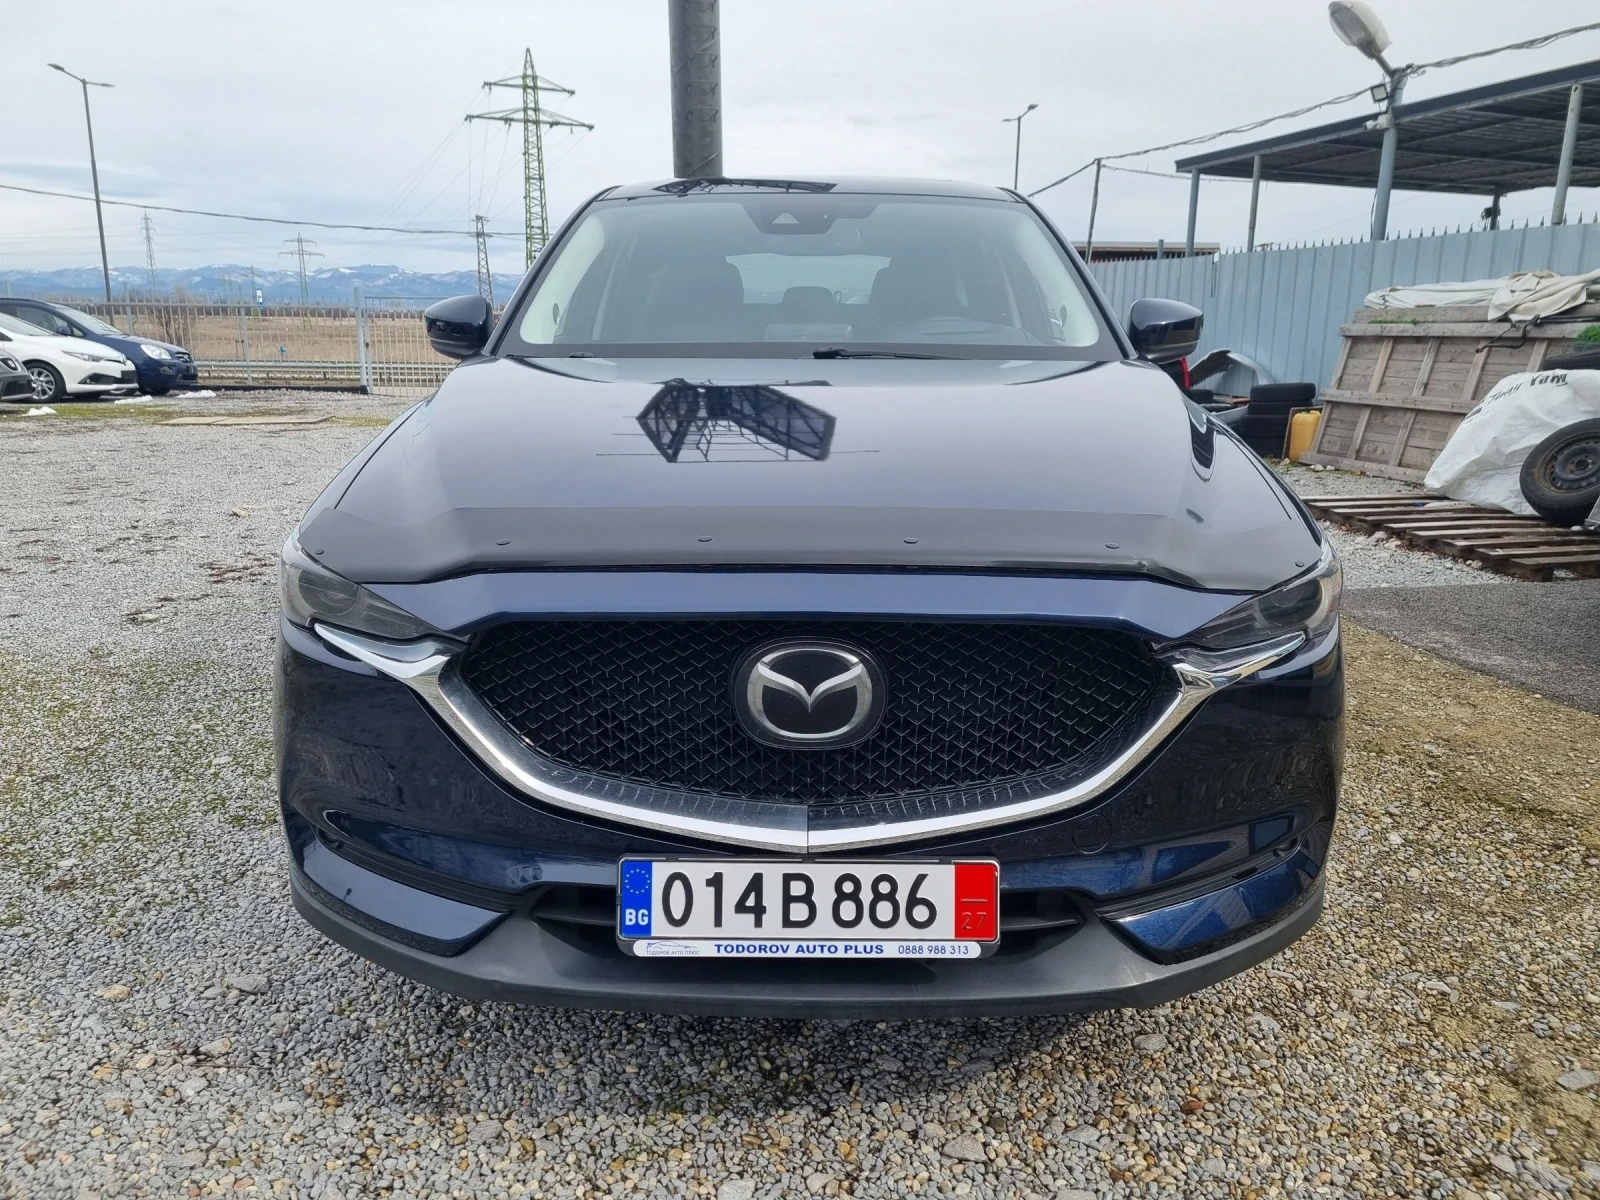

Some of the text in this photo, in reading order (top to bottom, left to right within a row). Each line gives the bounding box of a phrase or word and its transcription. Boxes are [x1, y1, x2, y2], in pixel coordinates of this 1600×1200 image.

[661, 871, 767, 928] 014
[831, 872, 938, 930] 886
[625, 908, 649, 926] BG
[961, 911, 988, 931] 27
[714, 944, 884, 955] TODOROV AUTO PLUS
[898, 945, 969, 955] 0888 988 313
